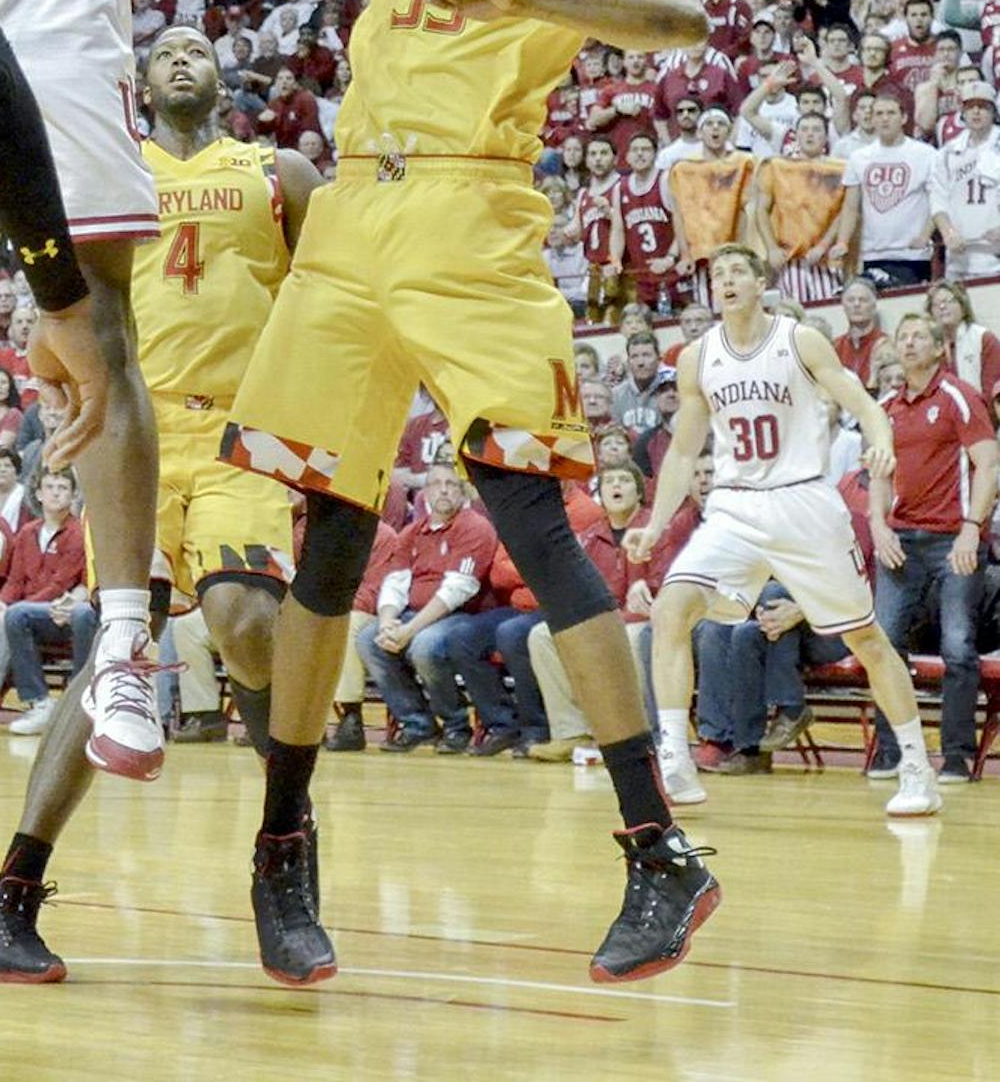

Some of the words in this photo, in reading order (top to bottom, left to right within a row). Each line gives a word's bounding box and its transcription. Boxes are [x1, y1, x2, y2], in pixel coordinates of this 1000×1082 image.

[158, 188, 243, 214] RYLAND
[637, 222, 657, 252] 3
[163, 221, 204, 295] 4
[710, 380, 794, 412] INDIANA
[729, 414, 780, 462] 30
